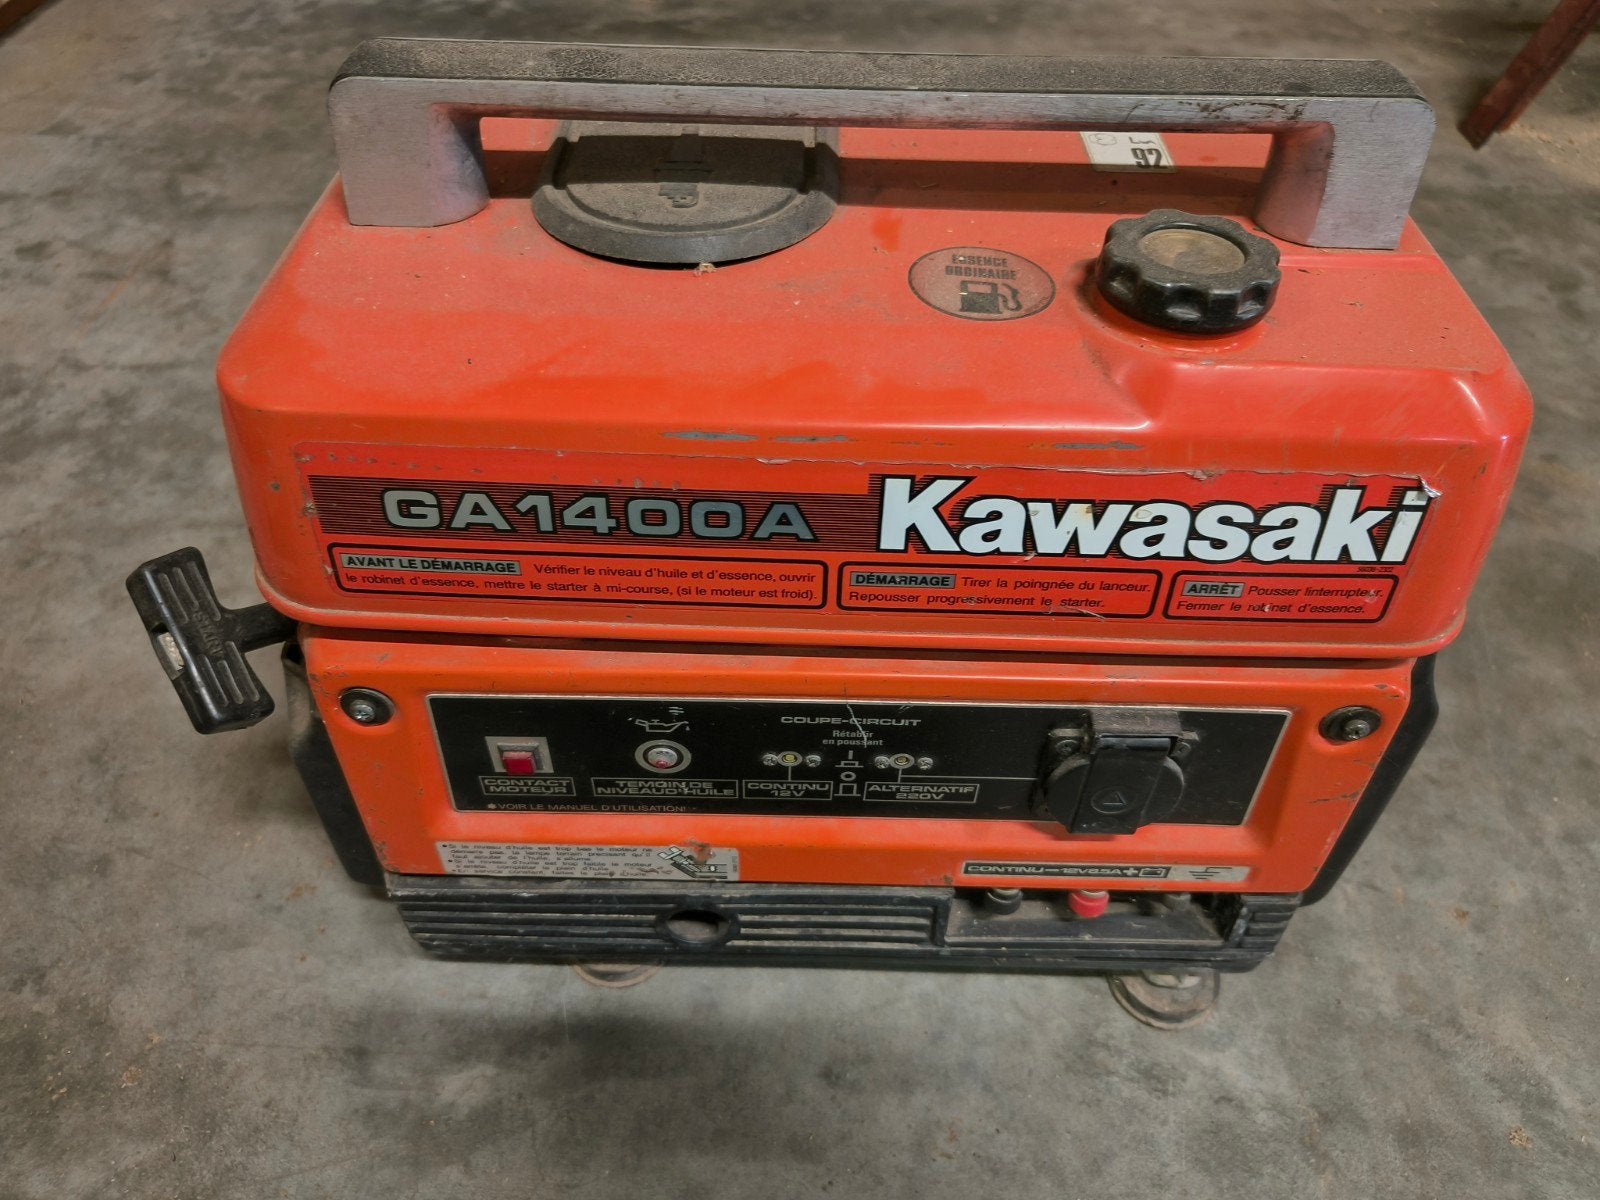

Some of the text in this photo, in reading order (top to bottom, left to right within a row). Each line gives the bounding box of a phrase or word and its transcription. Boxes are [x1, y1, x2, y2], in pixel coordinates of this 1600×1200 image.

[1131, 147, 1169, 169] 92
[382, 489, 818, 541] GA1400A
[876, 476, 1430, 564] Kawasaki
[346, 556, 817, 583] AVANT LE DÉMARRAGE Vérifier le niveau d'huile et d'essence, ouvrir
[346, 574, 357, 583] le
[362, 574, 405, 585] robinet
[484, 579, 525, 590] mettre
[530, 580, 542, 590] le
[547, 581, 587, 592] starter
[593, 582, 601, 592] à
[606, 583, 673, 595] mi-course,
[676, 585, 692, 597] (si
[696, 585, 706, 596] le
[711, 587, 755, 598] moteur
[759, 588, 778, 598] est
[781, 588, 817, 600] froid).
[855, 572, 1151, 592] DÉMARRAGE Tirer la poingnée du lanceur.
[1186, 582, 1240, 595] ARRÊT
[1247, 585, 1301, 596] Pousser
[850, 591, 1105, 608] Repousser progressivement le starter.
[1176, 601, 1365, 614] Fermer le robinet d'essence.
[781, 716, 922, 727] COUPE-CIRCUIT
[832, 730, 874, 738] Rétablir
[837, 738, 884, 746] poussant
[483, 778, 571, 787] CONTACT
[690, 781, 714, 789] DE
[747, 782, 830, 791] CONTINU
[489, 785, 567, 794] MOTEUR
[868, 784, 975, 793] ALTERNATIF
[895, 792, 945, 800] 220V
[498, 802, 528, 810] VOIR
[548, 803, 597, 812] MANUEL
[967, 865, 1045, 873] CONTINU
